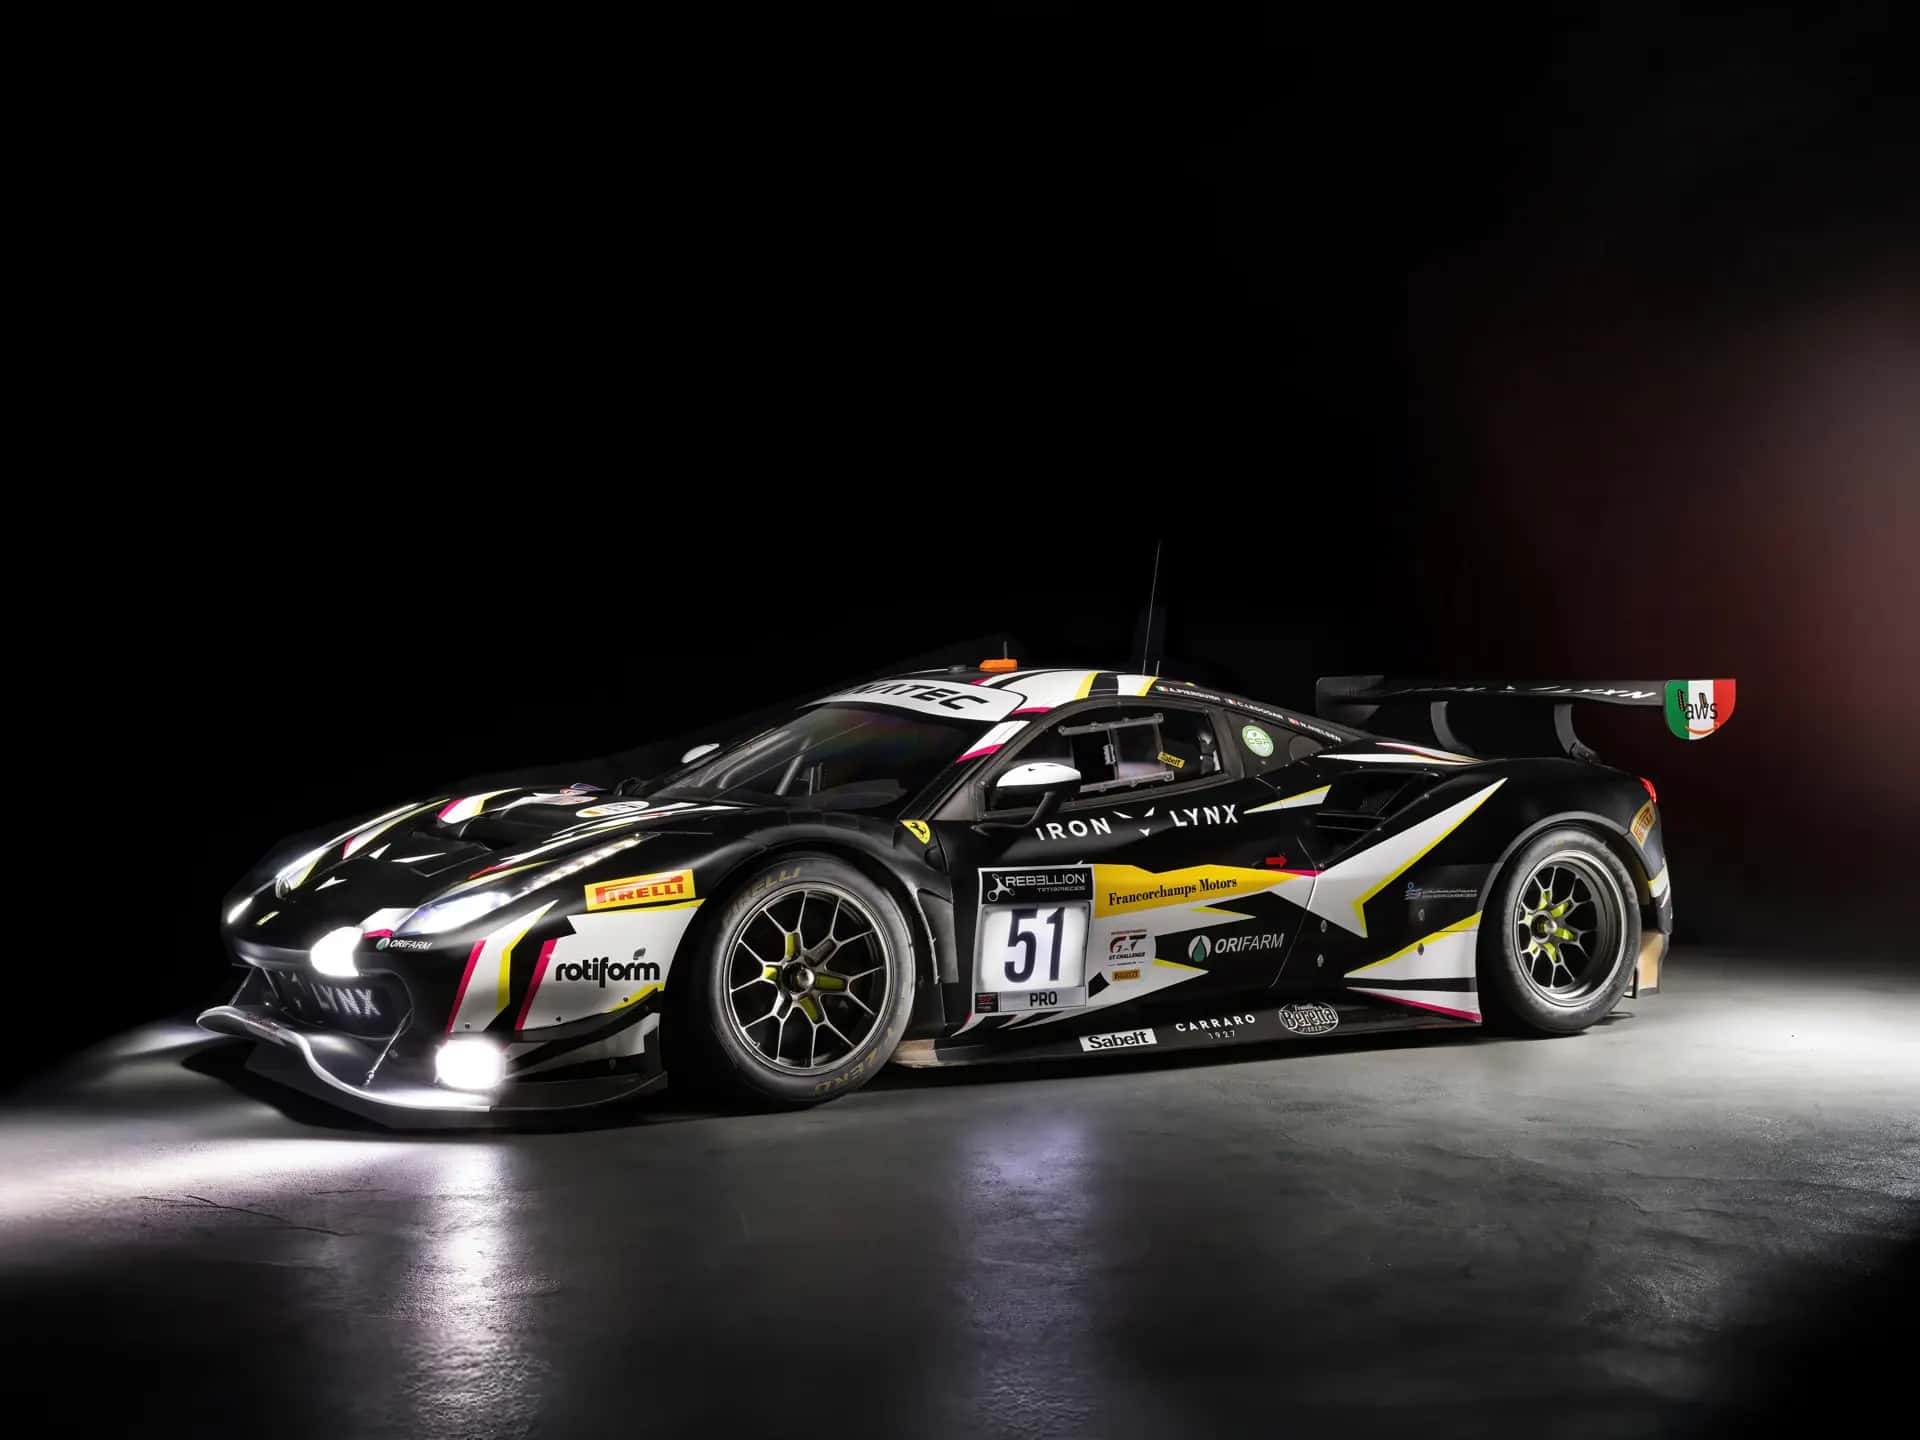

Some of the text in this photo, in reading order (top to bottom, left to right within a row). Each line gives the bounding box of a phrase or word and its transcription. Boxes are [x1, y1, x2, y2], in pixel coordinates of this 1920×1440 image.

[1684, 702, 1719, 720] aws
[1035, 804, 1239, 841] IRON LYNX
[595, 875, 684, 904] PIRELLI
[1005, 873, 1086, 888] REBELLION
[1108, 877, 1237, 906] Francorchamps Motors
[1004, 905, 1066, 983] 51
[1215, 933, 1285, 954] ORIFARM
[555, 956, 660, 988] rotiform
[311, 983, 381, 1016] LYNX
[1029, 991, 1058, 1007] PRO
[1175, 1014, 1256, 1032] CARRARO
[1088, 1031, 1149, 1050] Sabelt
